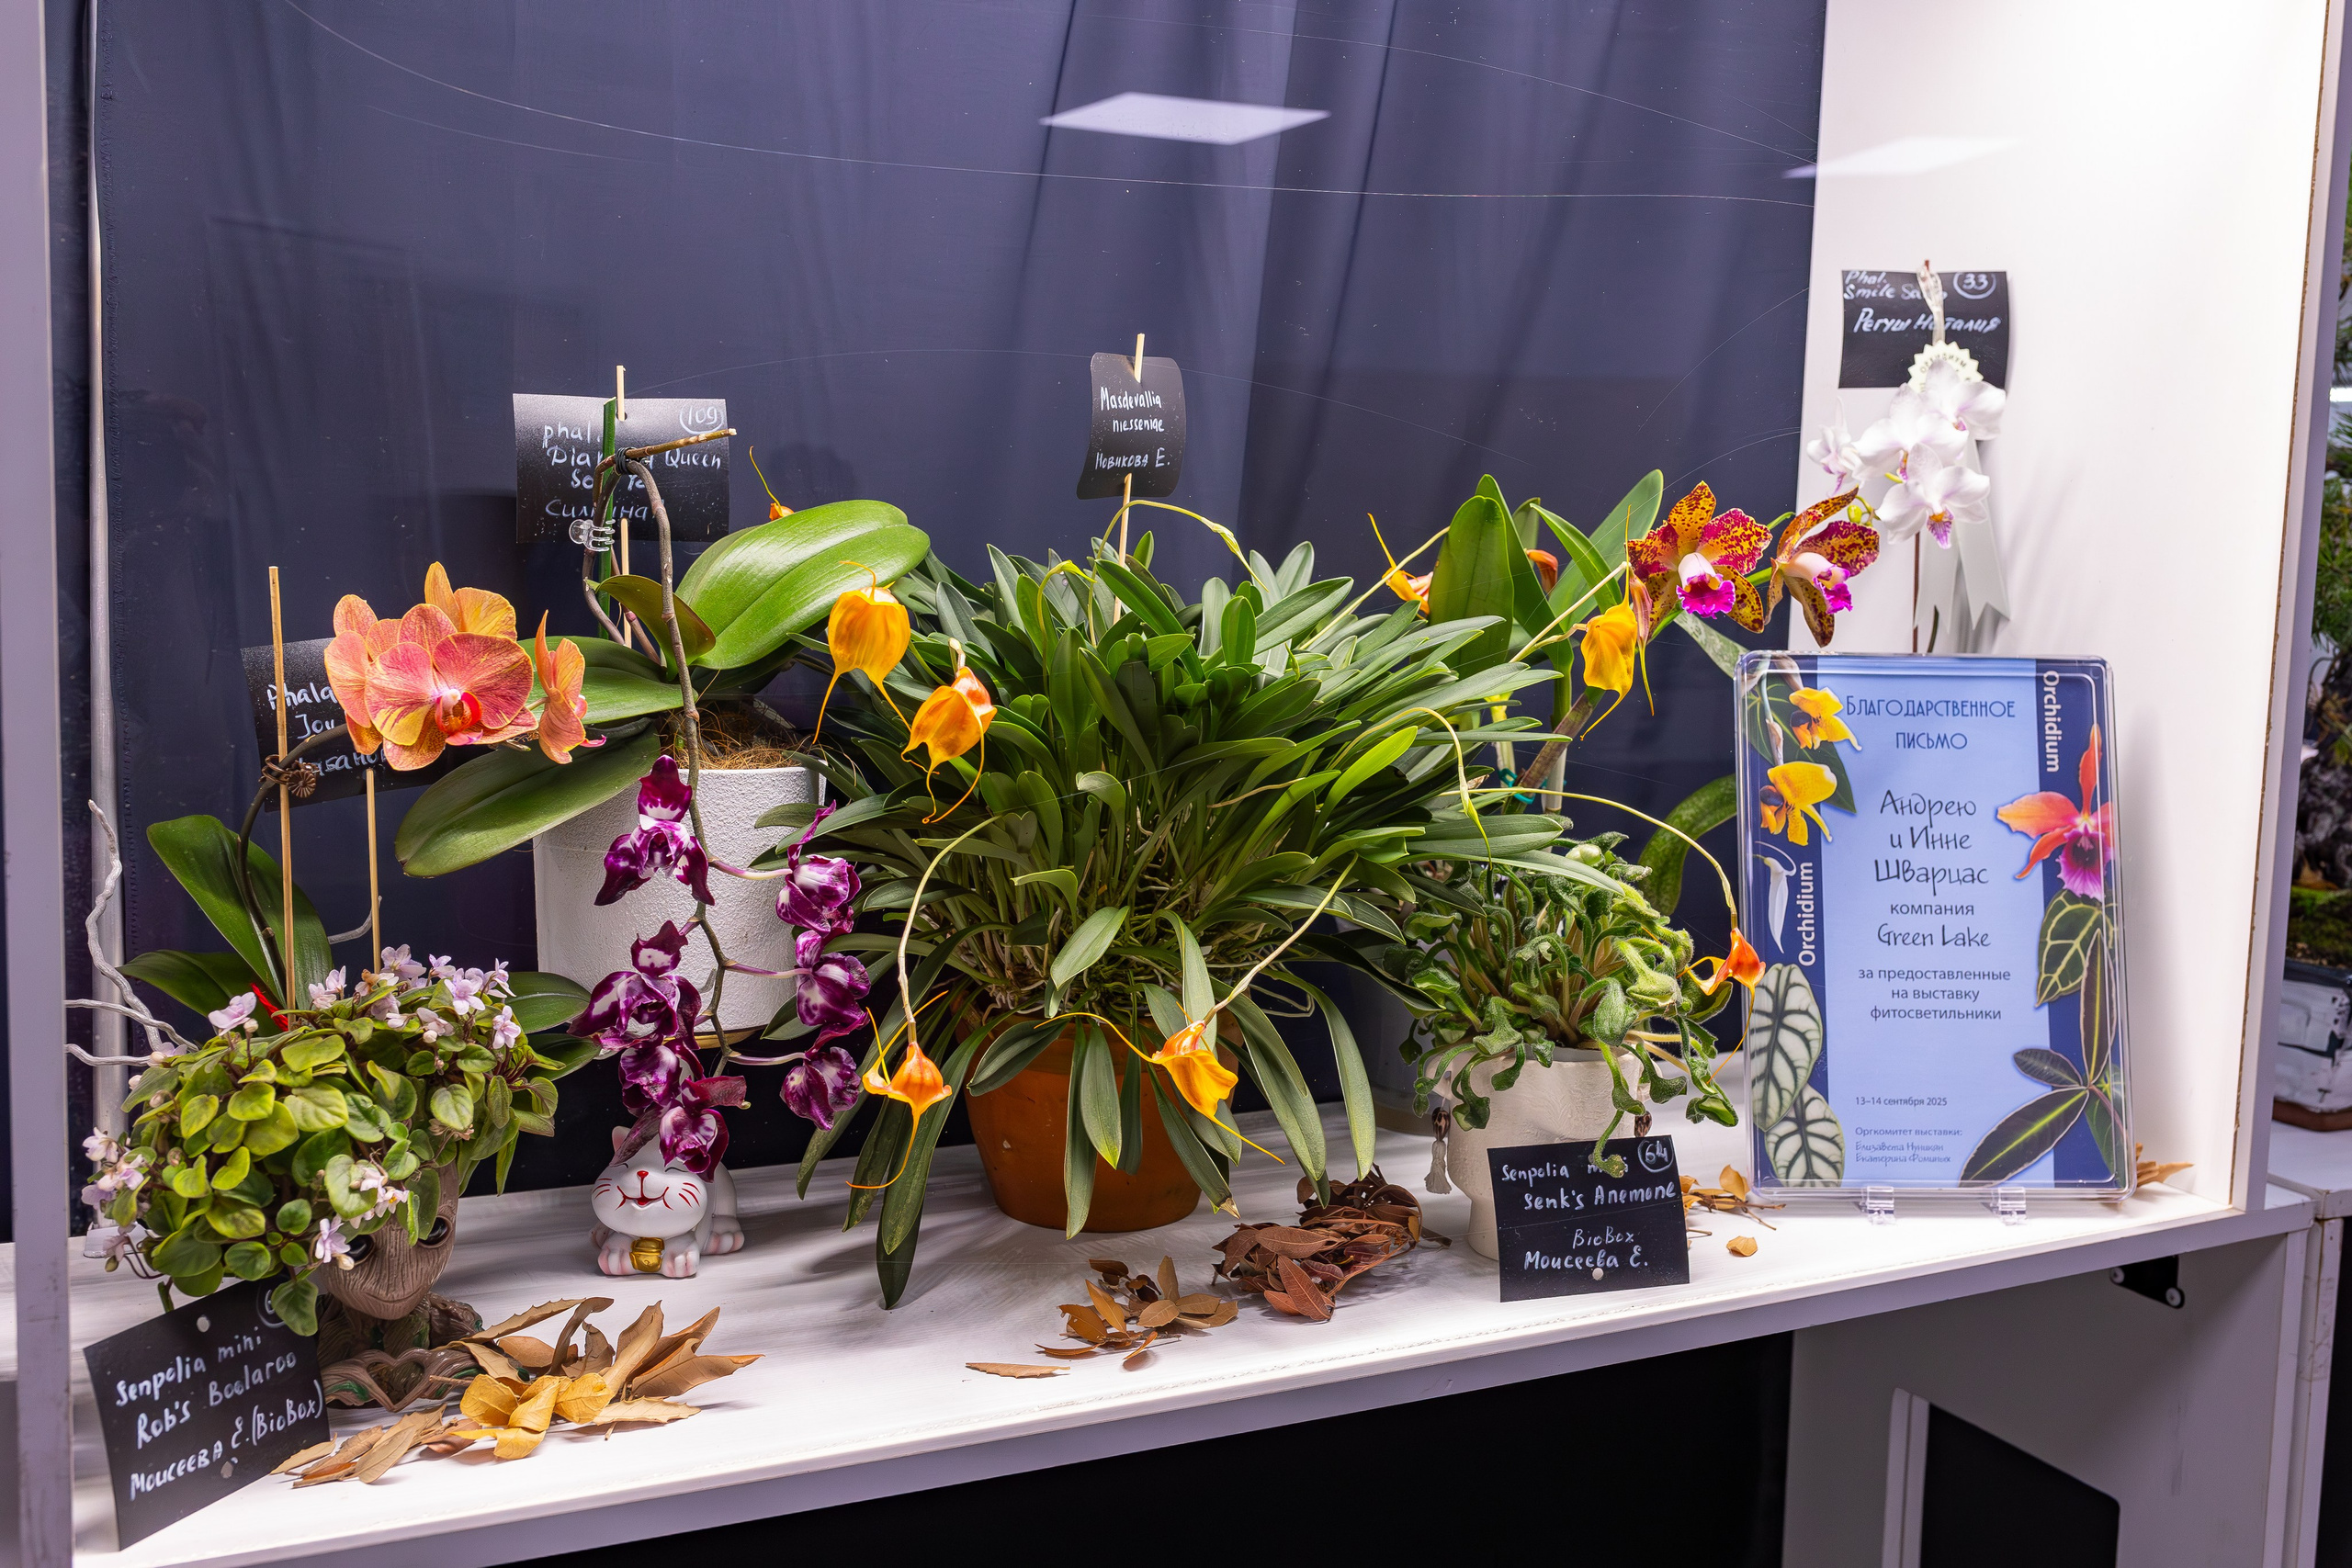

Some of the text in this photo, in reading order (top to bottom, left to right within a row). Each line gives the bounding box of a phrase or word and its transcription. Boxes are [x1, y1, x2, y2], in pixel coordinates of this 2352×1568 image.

[1962, 274, 1988, 289] 33
[1844, 284, 1895, 299] Smile
[1101, 387, 1161, 411] Masdevallia
[688, 406, 718, 425] 109
[664, 448, 721, 469] Queen
[2043, 670, 2060, 773] Orchidium
[1880, 789, 1977, 828] Андрею
[1891, 826, 1972, 851] и Инне
[1796, 862, 1816, 966] Orchidium
[1891, 904, 1973, 915] компания
[1878, 923, 1990, 947] Green Lake
[1859, 970, 2010, 982] за предоставленные
[1892, 989, 1979, 1002] на выставку
[1871, 1006, 2001, 1021] фитосветильники
[1883, 1097, 1924, 1107] сентября
[1927, 1097, 1948, 1106] 2025
[1855, 1127, 1912, 1136] Оргкомитет
[1856, 1140, 1904, 1153] Елизавета
[1856, 1152, 1906, 1167] Екатерина
[1524, 1181, 1676, 1210] Senk's Anemone
[1572, 1225, 1634, 1249] BioBox
[137, 1400, 191, 1450] Rob's
